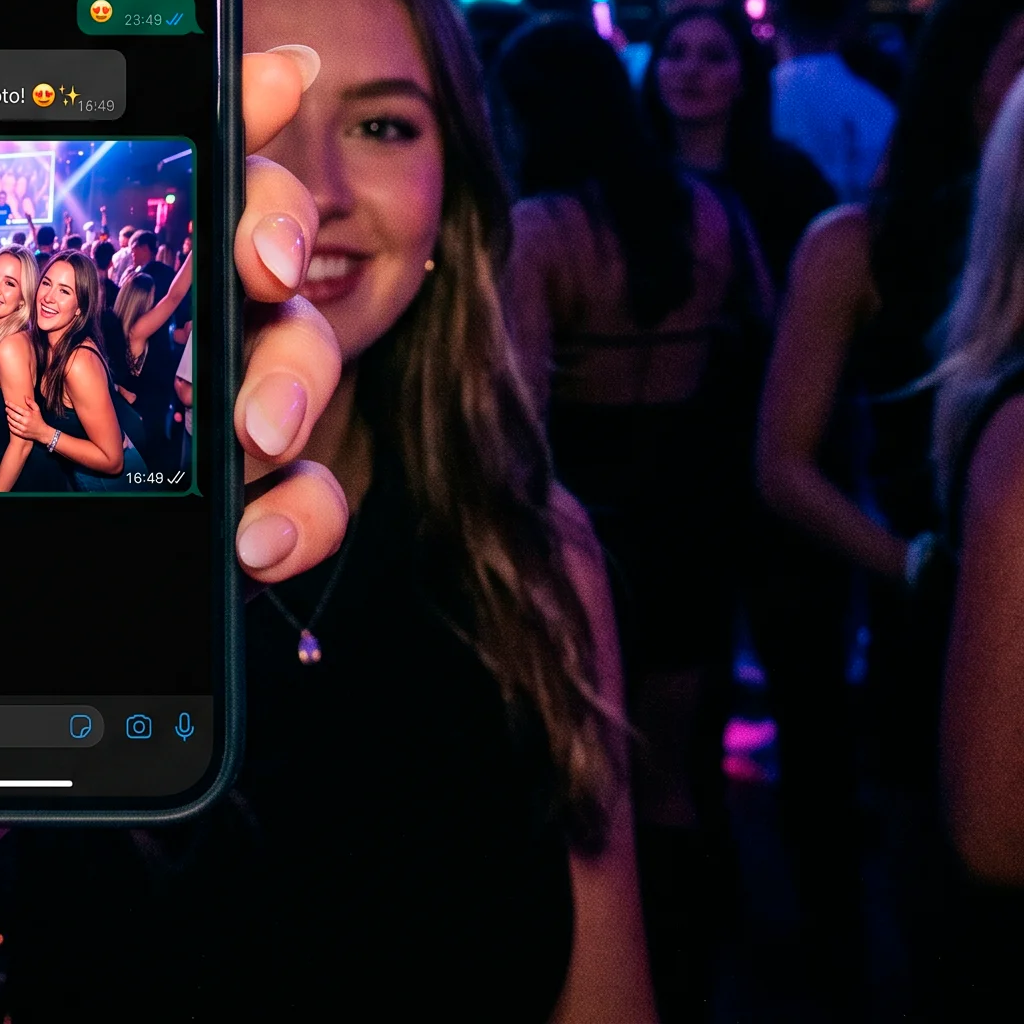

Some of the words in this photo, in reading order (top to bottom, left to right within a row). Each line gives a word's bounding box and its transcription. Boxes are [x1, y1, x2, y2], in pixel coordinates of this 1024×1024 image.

[124, 14, 163, 26] 23:49
[77, 99, 115, 112] 16:49
[125, 471, 164, 484] 16:49
